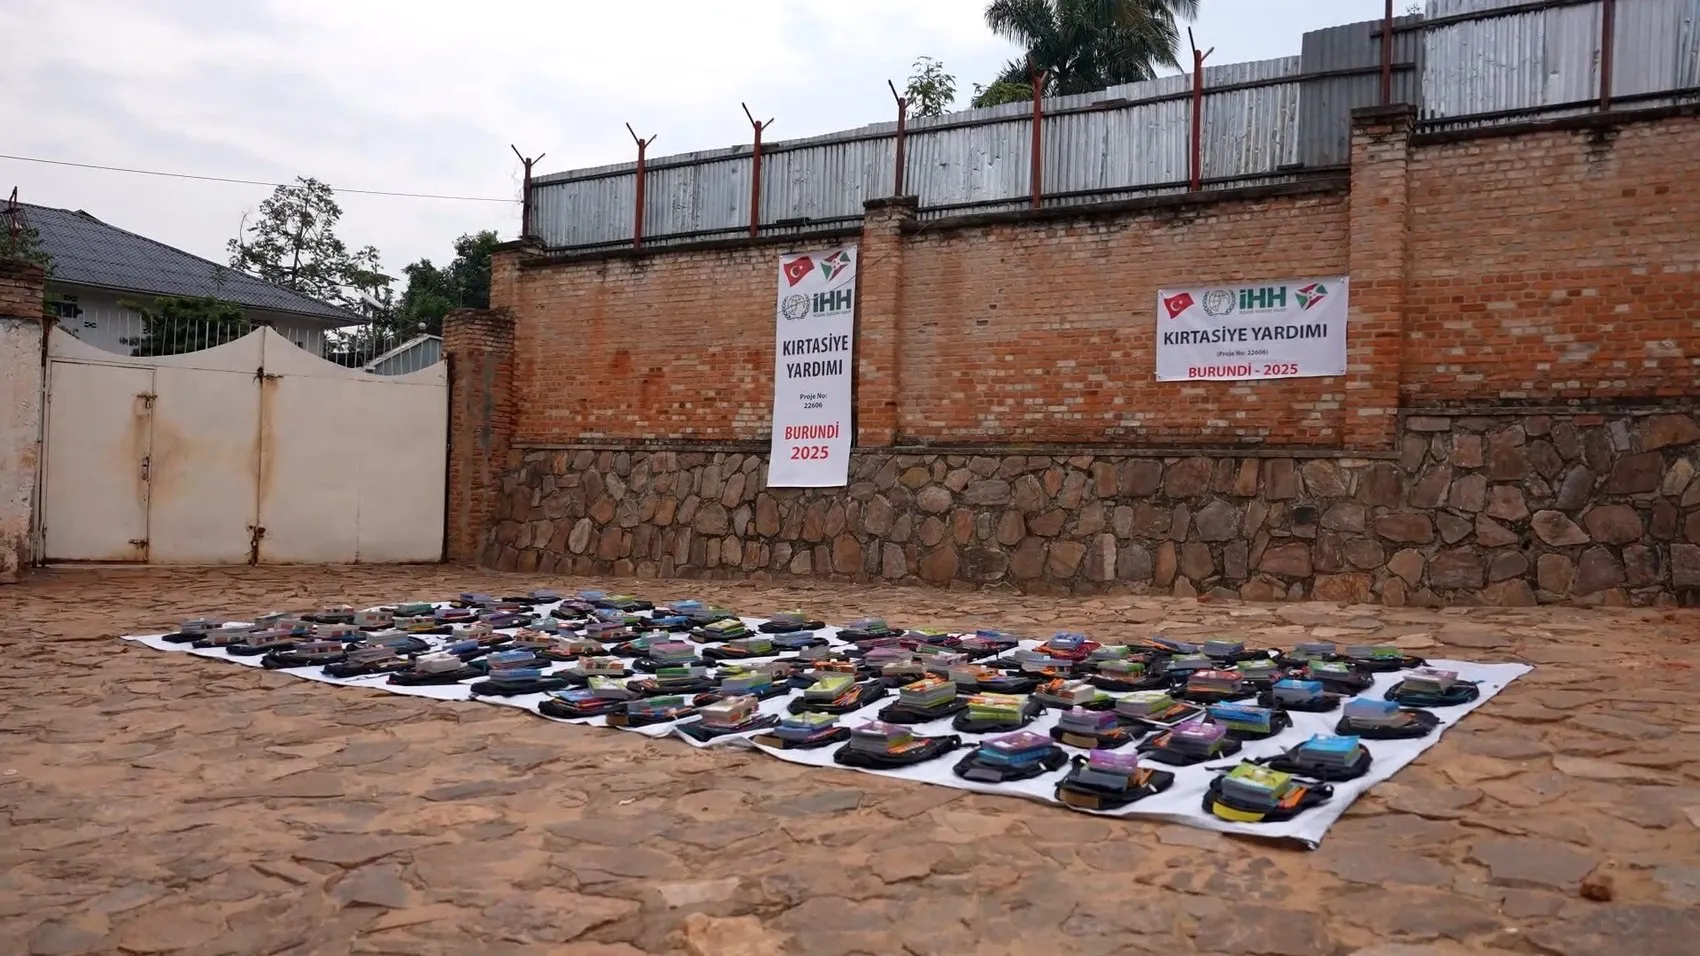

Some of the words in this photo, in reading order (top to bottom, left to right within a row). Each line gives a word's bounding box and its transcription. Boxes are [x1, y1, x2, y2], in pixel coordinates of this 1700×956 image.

[1163, 326, 1247, 346] KIRTASİYE
[1251, 324, 1328, 341] YARDIMI
[782, 333, 849, 356] KIRTASİYE
[1216, 350, 1234, 358] (Proje
[786, 359, 843, 379] YARDIMI
[1188, 362, 1252, 378] BURUNDİ
[1263, 363, 1298, 376] 2025
[799, 393, 815, 401] Proje
[816, 392, 828, 400] No:
[784, 421, 840, 440] BURUNDİ
[790, 446, 829, 460] 2025
